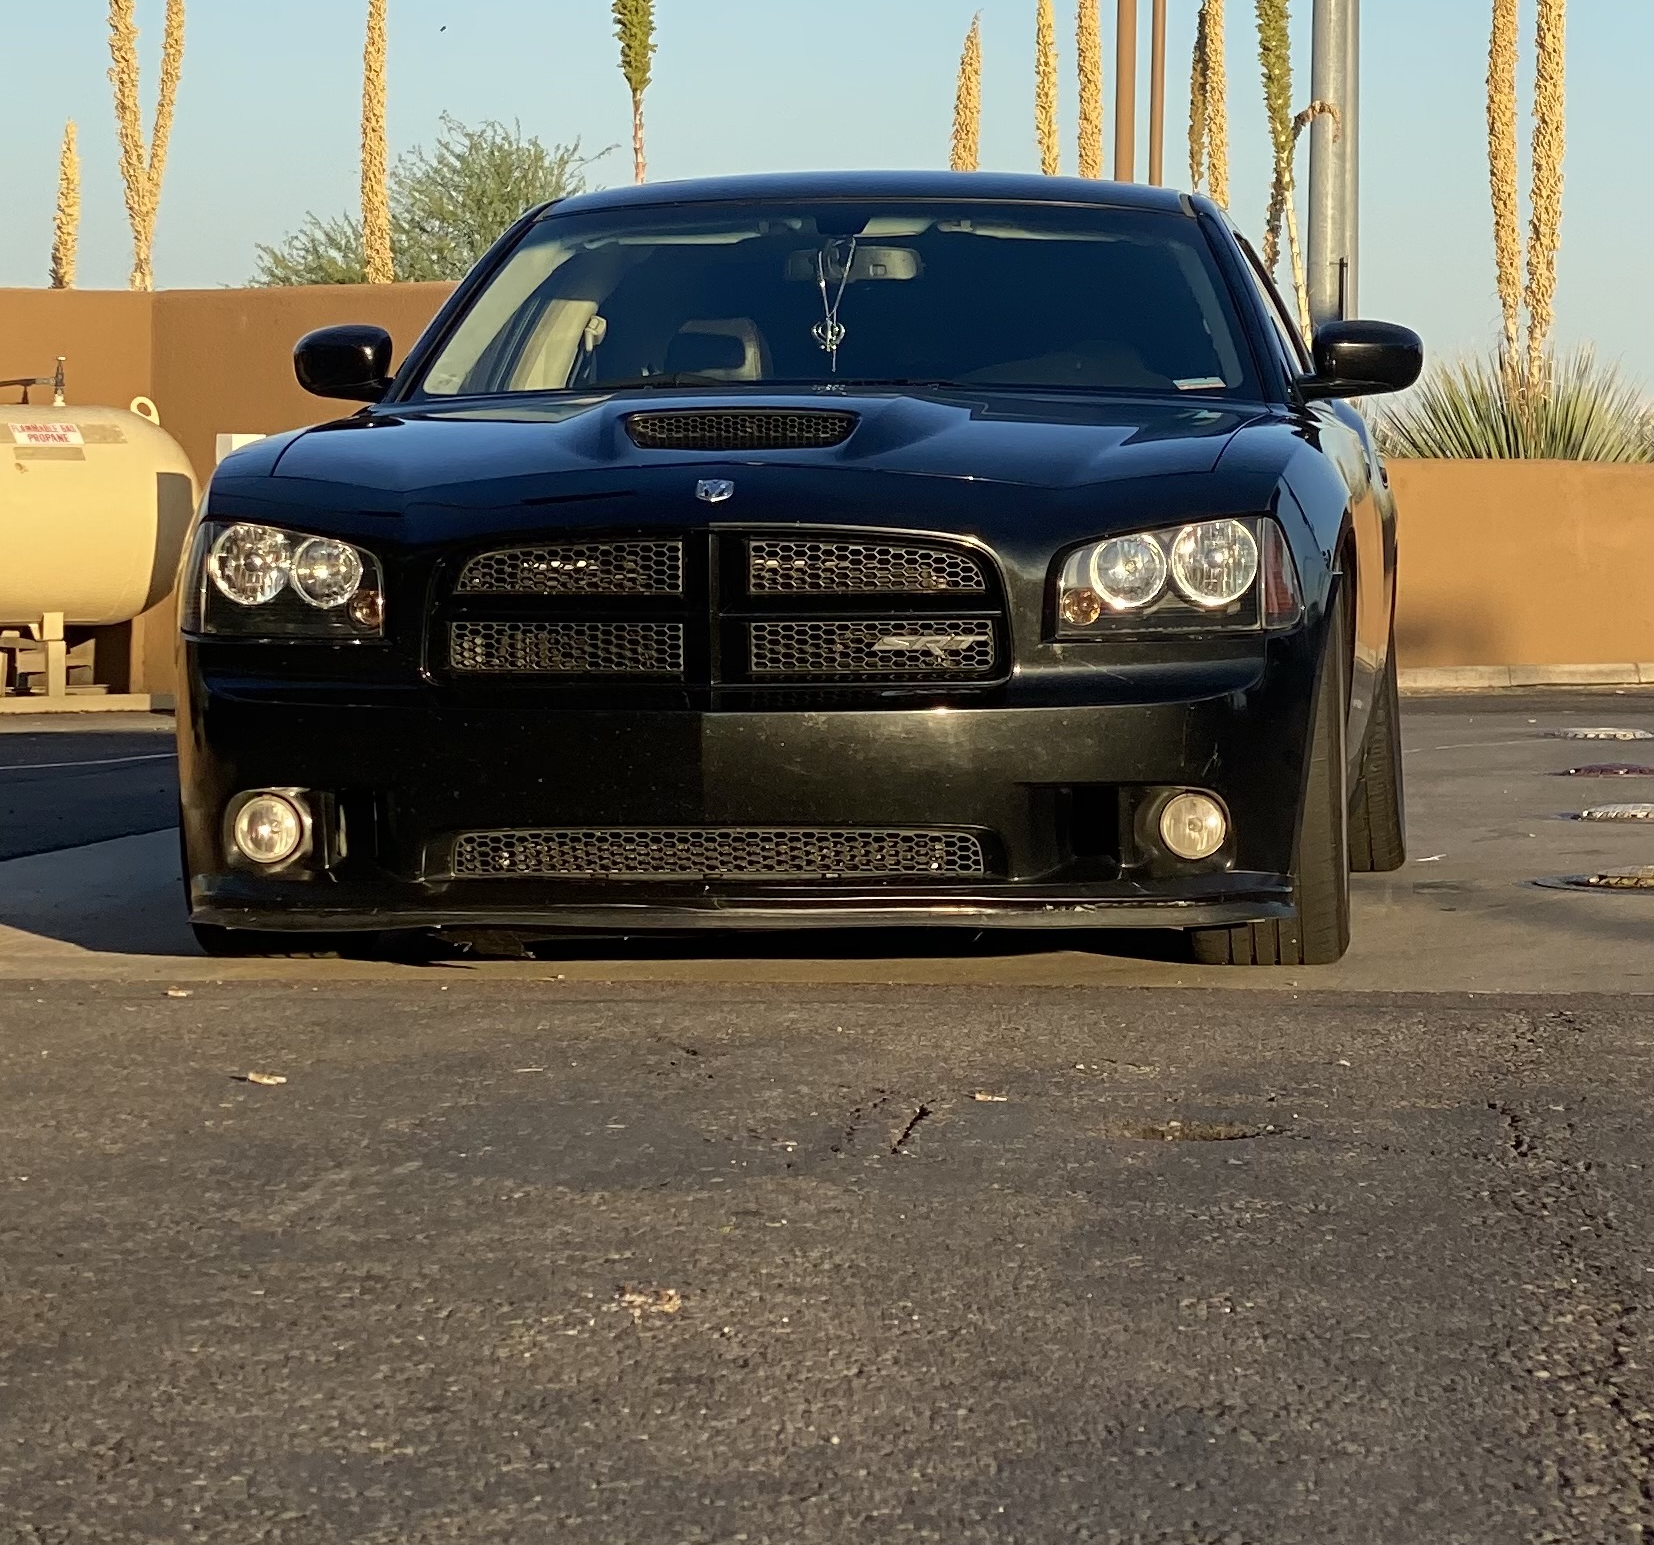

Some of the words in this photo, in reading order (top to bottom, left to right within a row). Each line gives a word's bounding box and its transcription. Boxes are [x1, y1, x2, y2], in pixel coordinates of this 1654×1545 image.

[11, 424, 59, 433] FLAMMABLE
[27, 433, 71, 443] PROPANE
[871, 635, 988, 658] SRT
